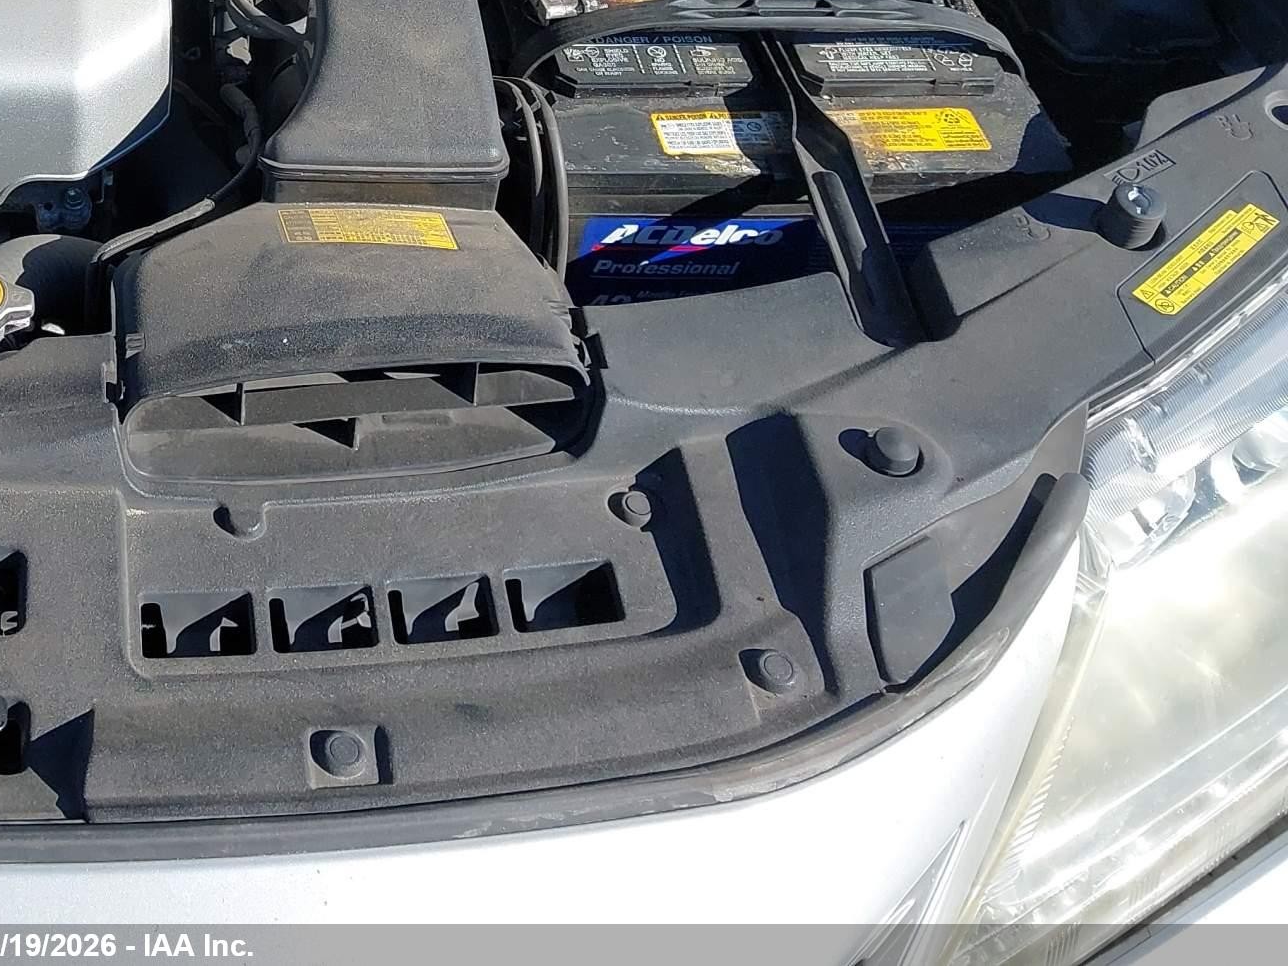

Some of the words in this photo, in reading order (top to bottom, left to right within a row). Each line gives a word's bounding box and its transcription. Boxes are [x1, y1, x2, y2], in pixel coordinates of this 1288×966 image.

[595, 36, 650, 44] DANGER
[663, 35, 713, 44] POISON
[601, 224, 783, 246] ACDelco
[593, 259, 740, 276] Professional
